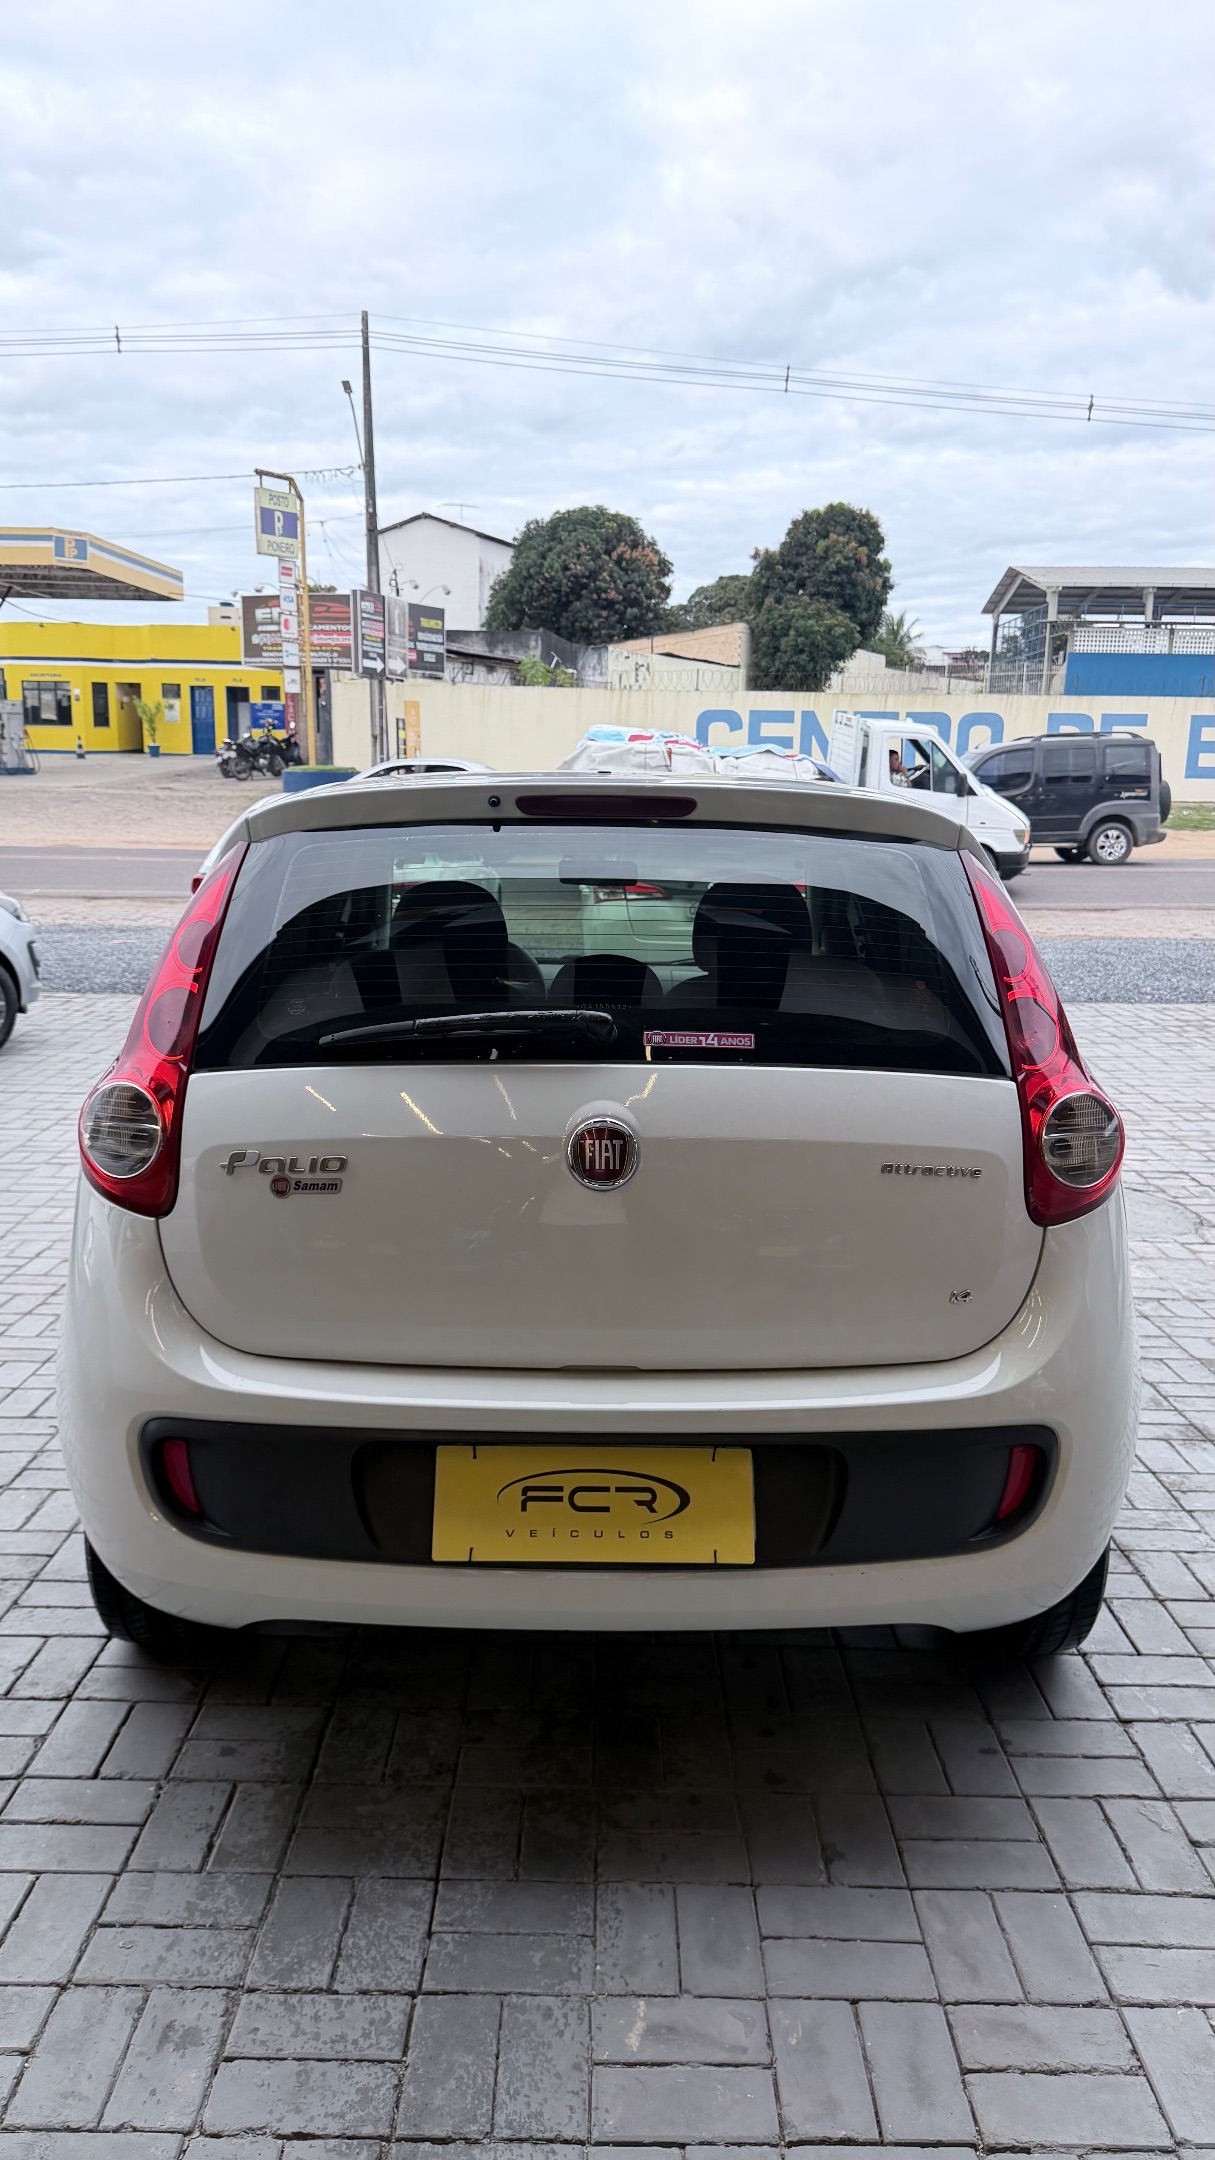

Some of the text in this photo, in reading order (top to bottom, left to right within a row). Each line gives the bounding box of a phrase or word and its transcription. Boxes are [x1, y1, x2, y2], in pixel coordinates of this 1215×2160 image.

[268, 493, 289, 508] POSTO
[669, 1034, 698, 1045] LÍDER
[699, 1033, 719, 1046] 14
[720, 1037, 750, 1046] ANOS
[585, 1139, 624, 1170] FIAT
[293, 1180, 338, 1191] Samam
[520, 1485, 658, 1513] FCR
[505, 1526, 674, 1539] VEÍCULOS
